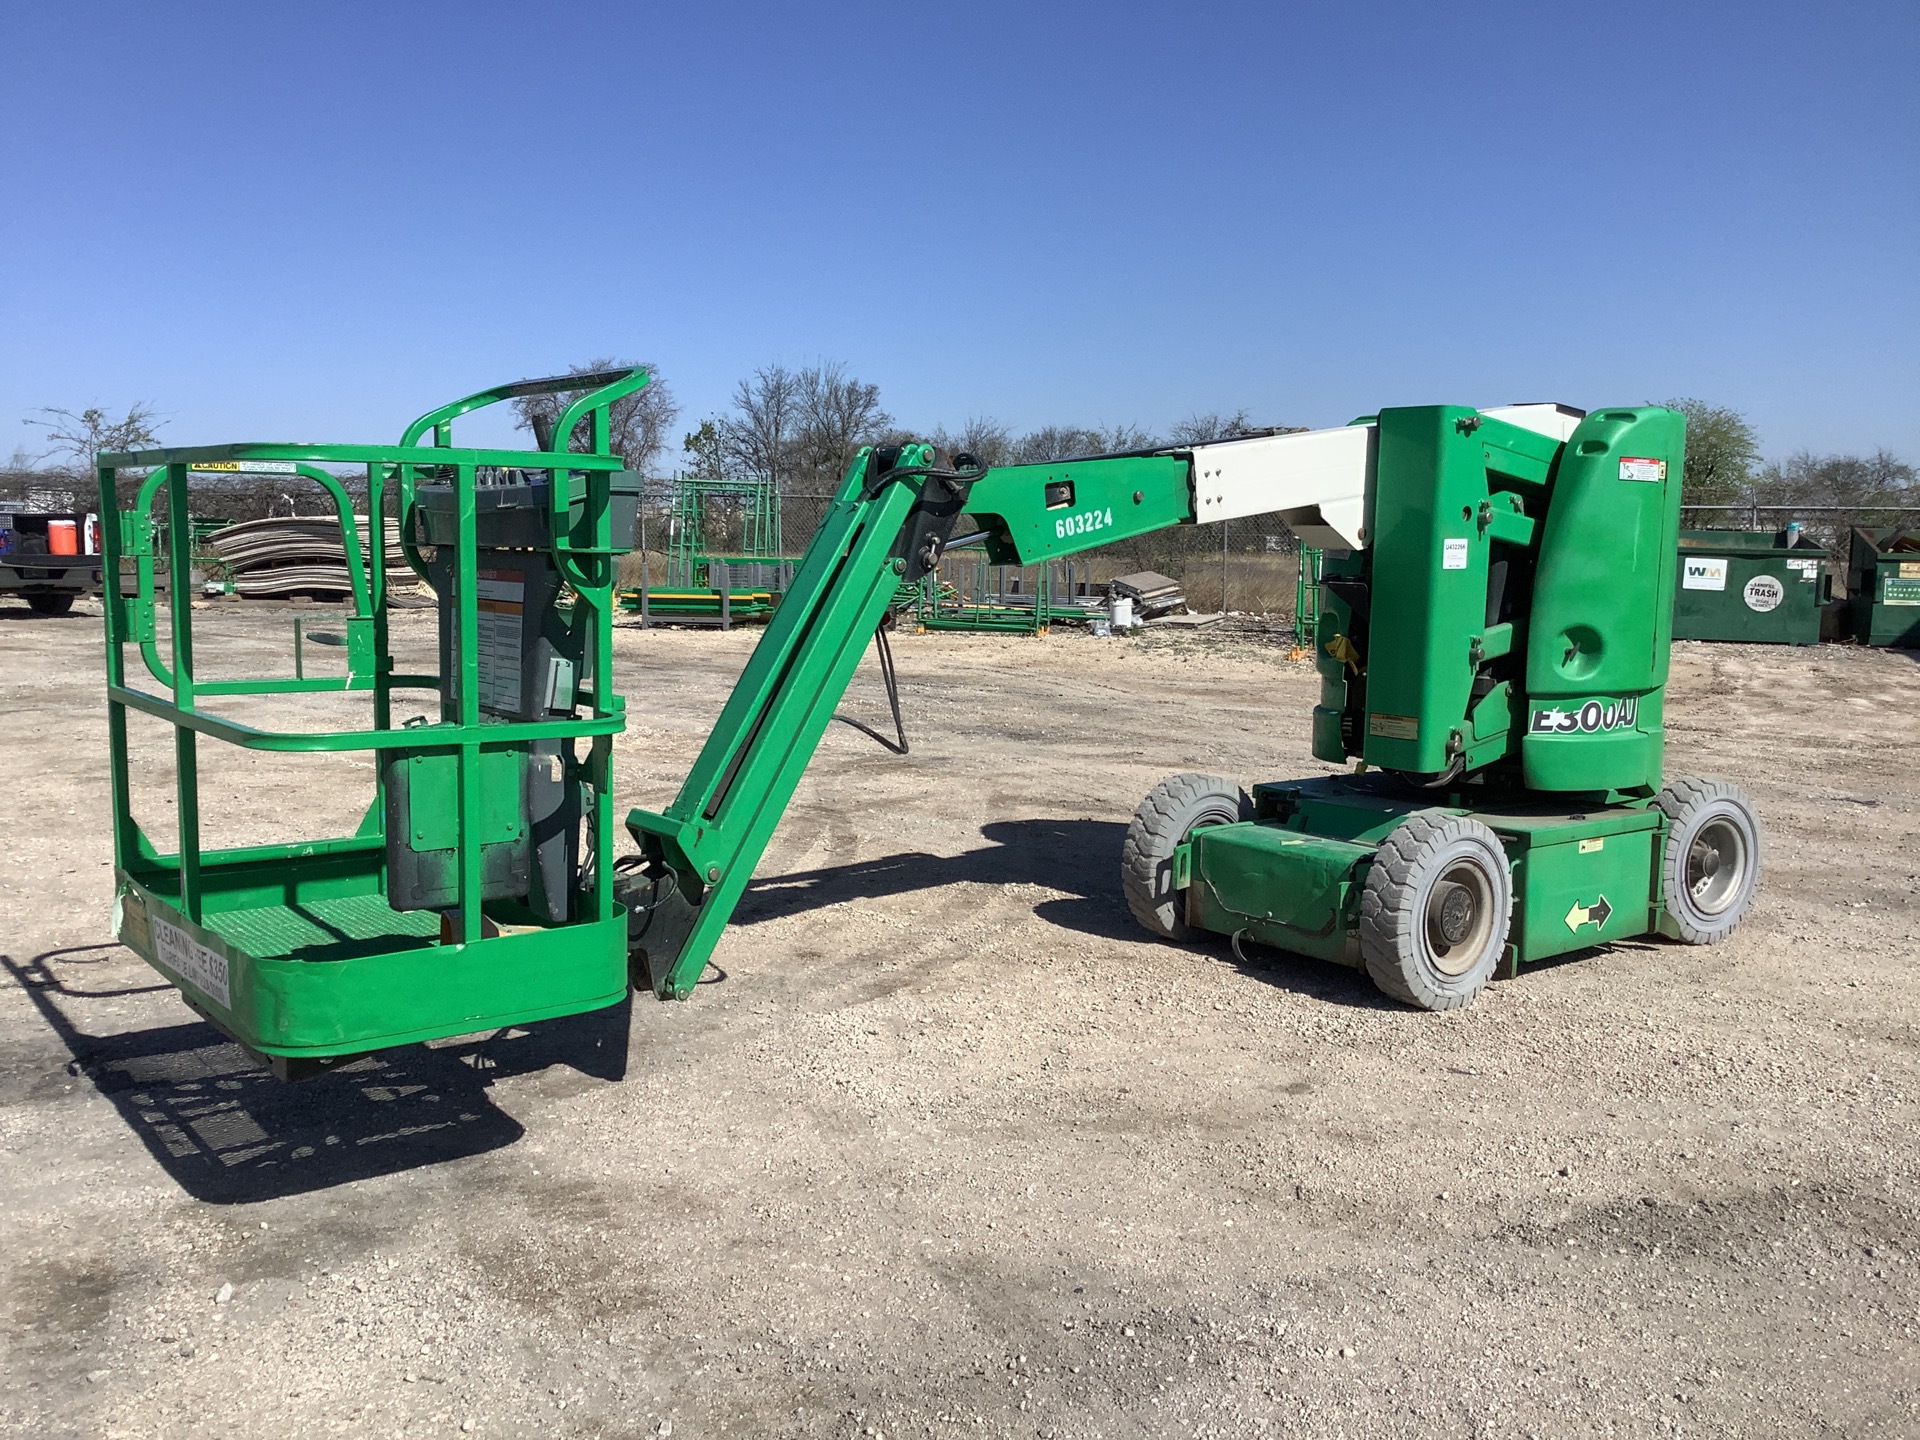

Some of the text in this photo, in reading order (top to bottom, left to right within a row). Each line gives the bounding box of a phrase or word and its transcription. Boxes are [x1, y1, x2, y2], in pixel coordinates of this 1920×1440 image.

[1055, 507, 1112, 539] 603224
[1689, 566, 1721, 577] WM
[1750, 588, 1778, 598] TRASH
[154, 919, 193, 960] CLEANING
[209, 955, 228, 986] $350
